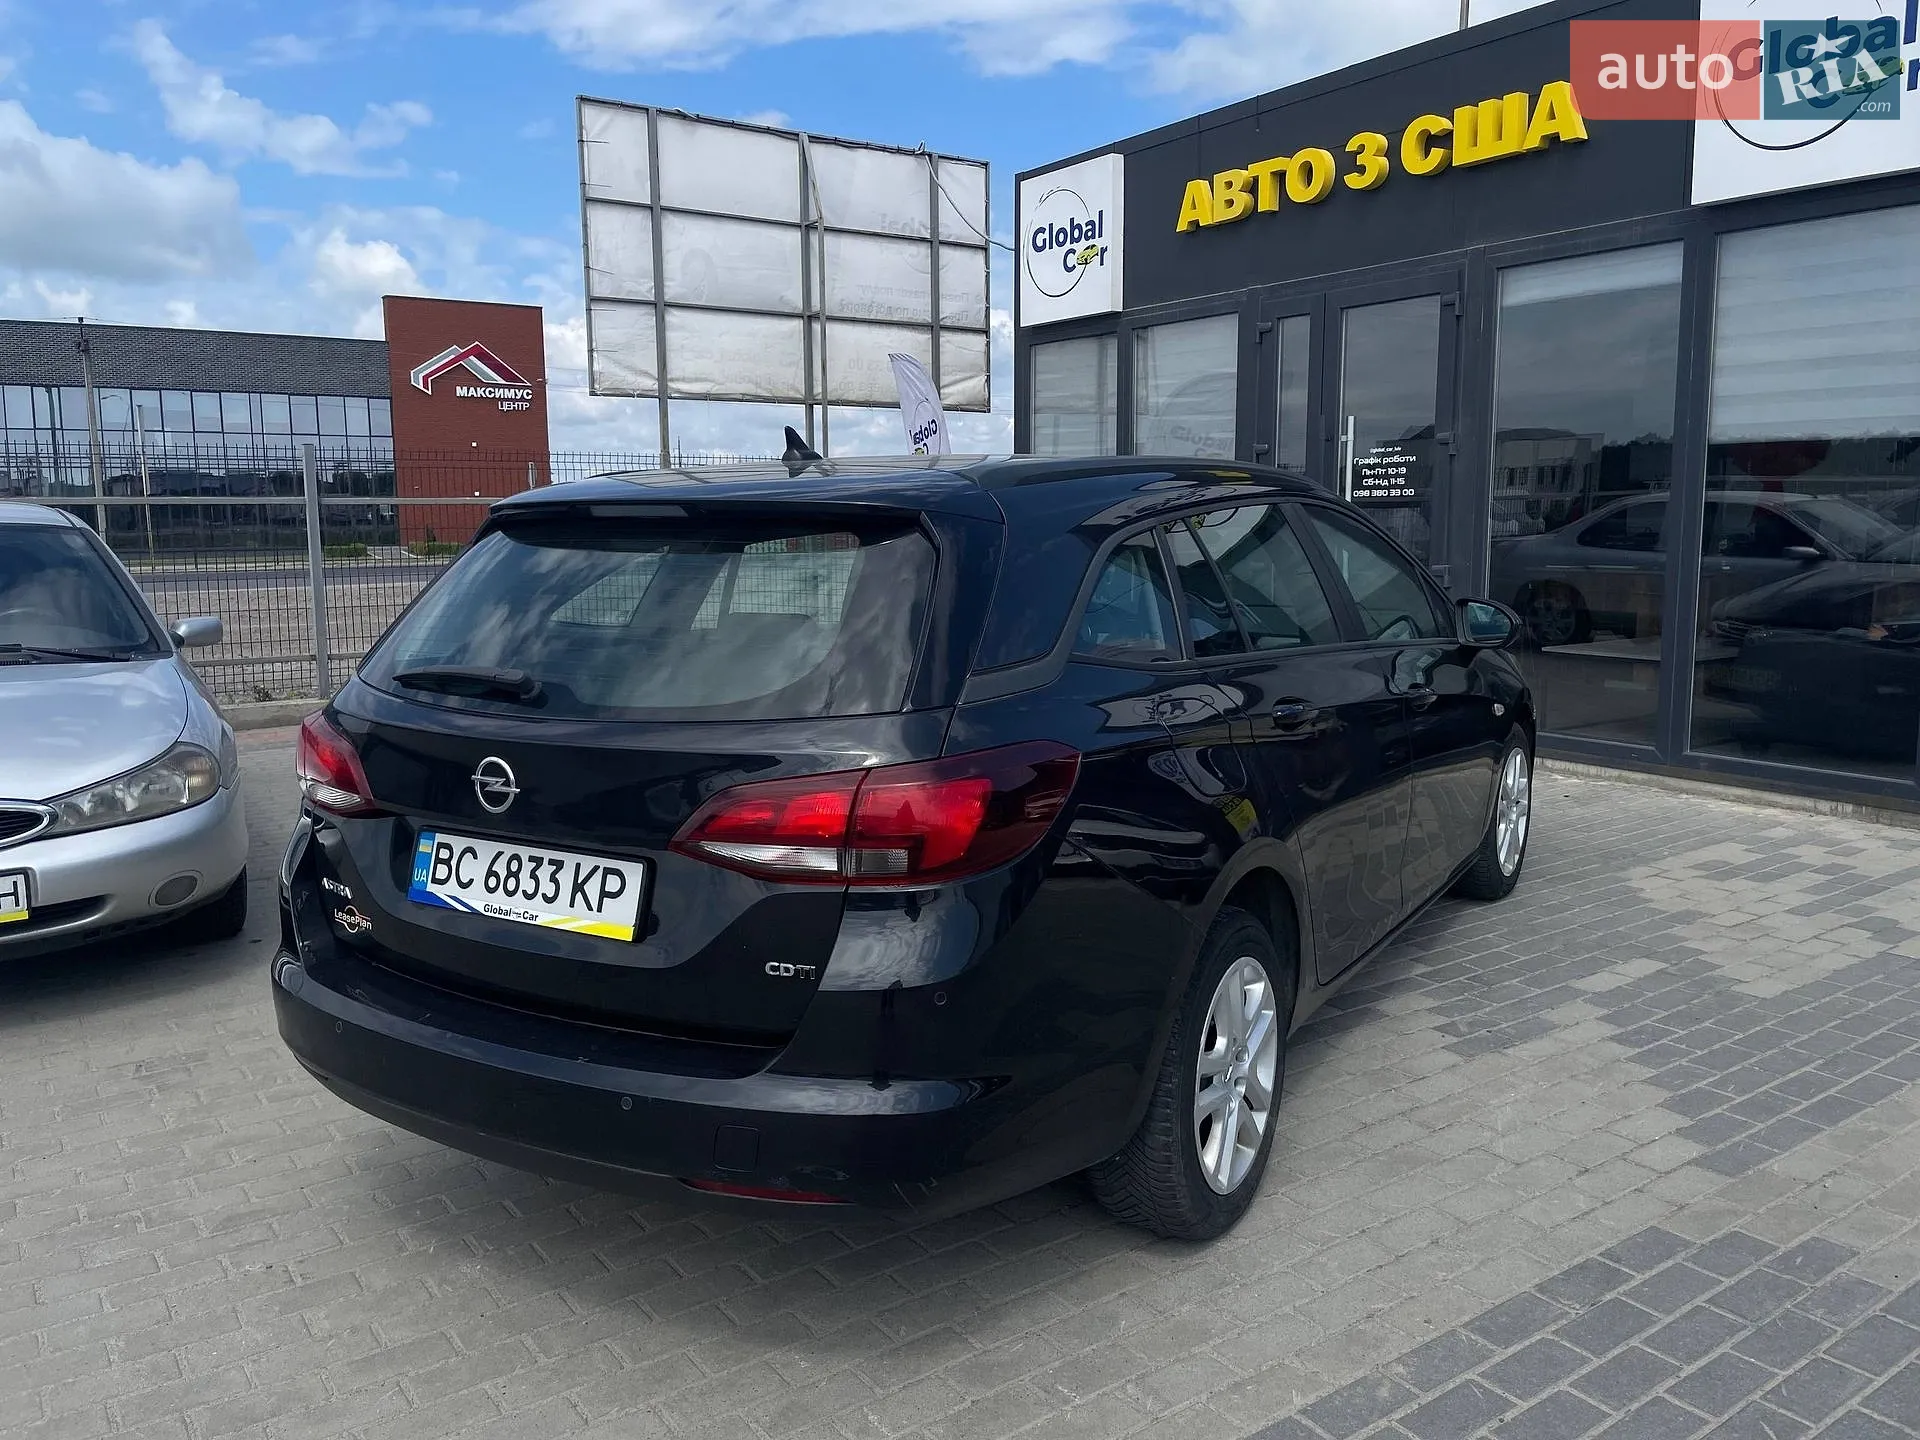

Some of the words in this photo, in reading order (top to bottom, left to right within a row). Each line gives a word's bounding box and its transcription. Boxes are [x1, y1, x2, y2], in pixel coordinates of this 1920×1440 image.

[1806, 55, 1920, 109] Cr
[1176, 147, 1336, 233] АВТО
[1401, 80, 1588, 176] США
[1032, 210, 1103, 253] Global
[1062, 244, 1108, 273] Cr
[456, 386, 532, 400] МАКСИМУС
[498, 401, 530, 412] ЦЕНТР
[1353, 456, 1382, 466] Графік
[1383, 454, 1416, 464] роботи
[1387, 467, 1407, 475] 10-19
[1363, 478, 1389, 486] Сб-Нд
[1390, 477, 1405, 485] 11-15
[413, 868, 428, 883] UA
[430, 841, 478, 890] BC
[484, 850, 565, 904] 6833
[569, 862, 627, 913] KP
[334, 908, 372, 930] LeasePlan
[483, 903, 512, 918] Global
[522, 911, 539, 922] Car
